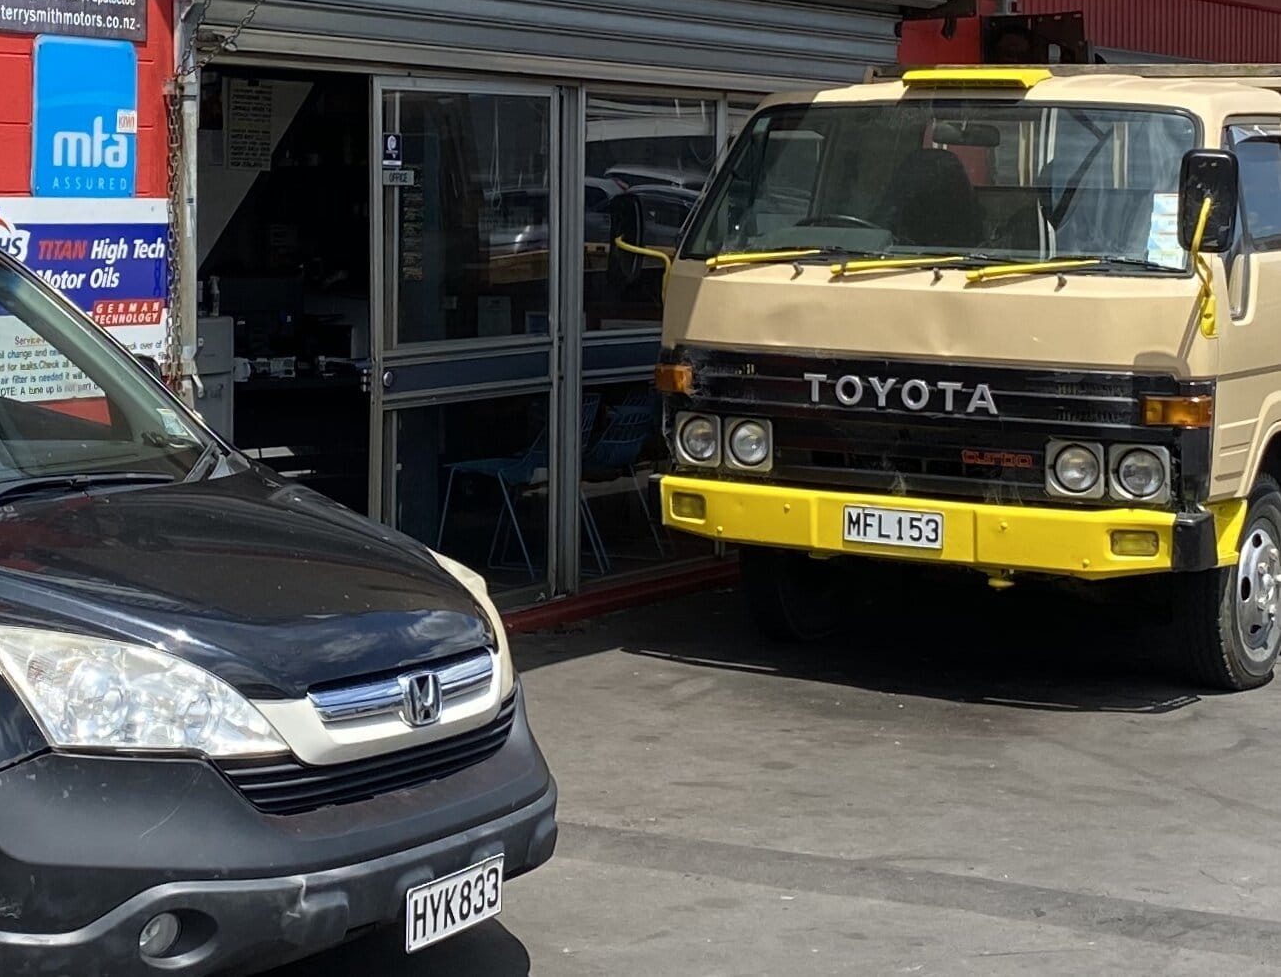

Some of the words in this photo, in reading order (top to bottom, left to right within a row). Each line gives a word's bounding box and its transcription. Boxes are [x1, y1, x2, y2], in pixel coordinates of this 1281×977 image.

[53, 116, 128, 168] mta
[53, 177, 126, 190] ASSURED
[38, 240, 90, 261] TITAN
[90, 238, 128, 264] High
[133, 237, 165, 259] Tech
[90, 267, 119, 288] Oils
[94, 313, 159, 324] TECHNOLOGY
[96, 302, 160, 313] GERMAN
[7, 350, 32, 360] change
[803, 373, 998, 415] TOYOTA
[847, 511, 939, 543] MFL153
[413, 867, 499, 942] HYK833
